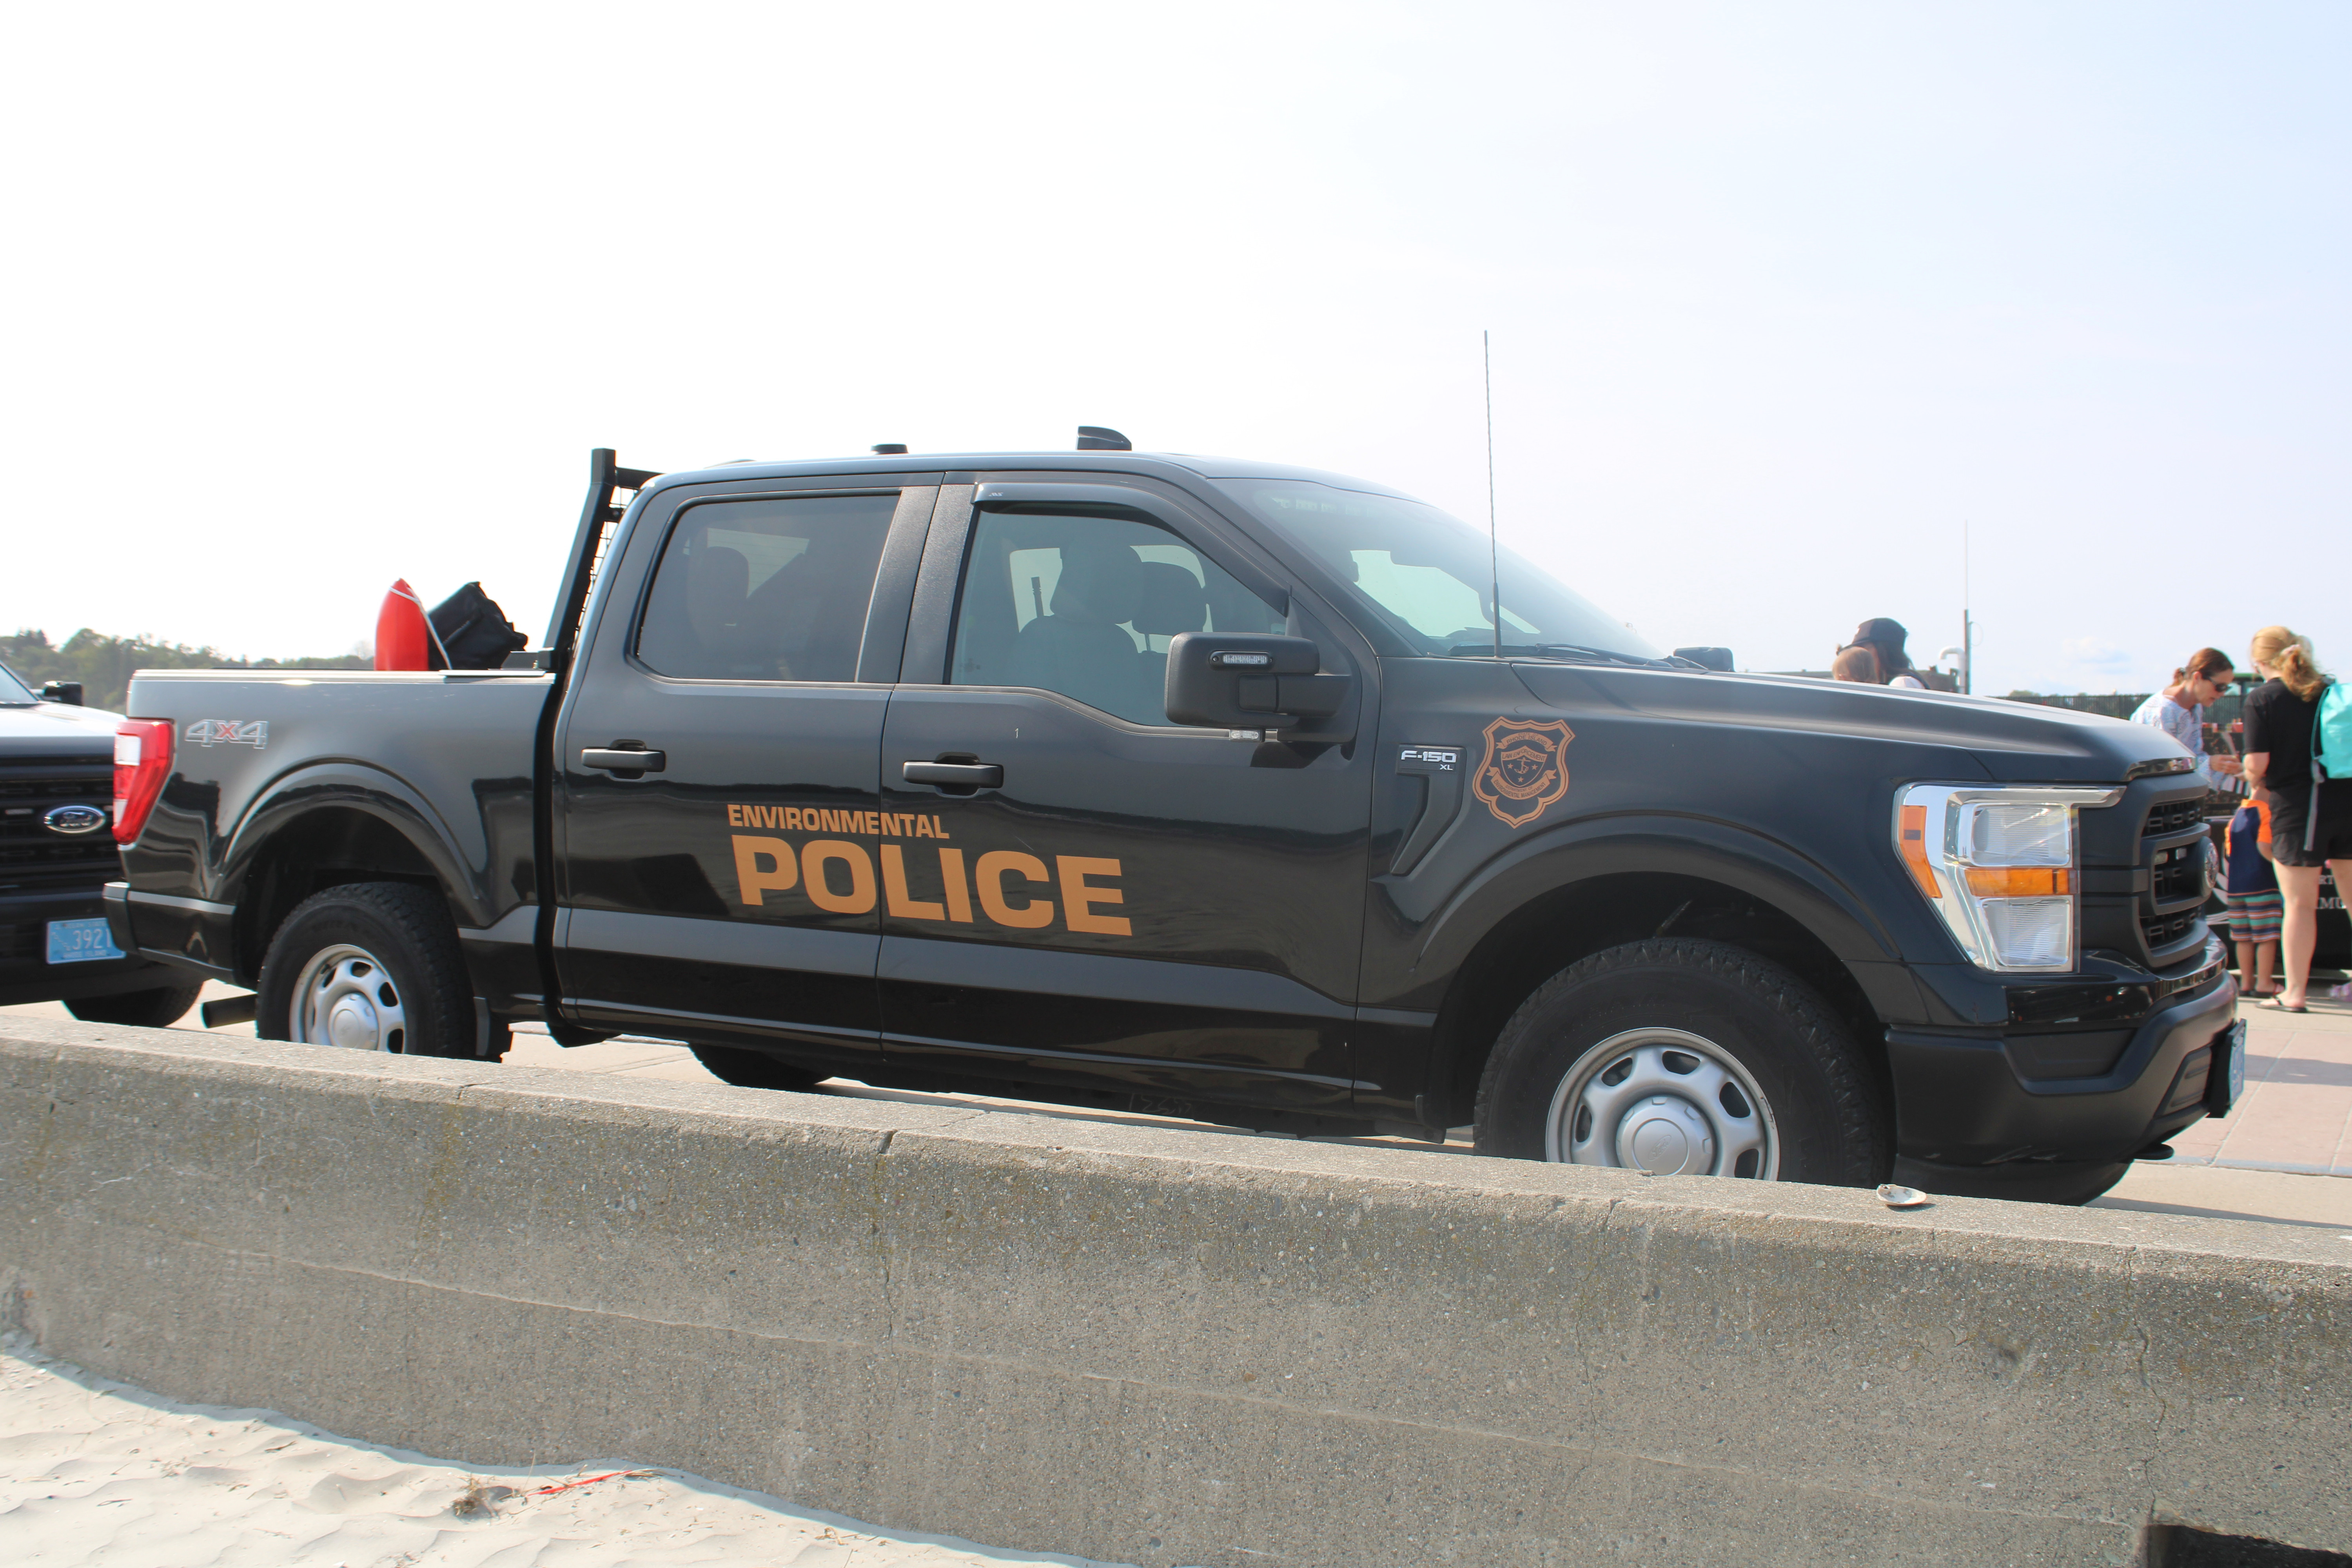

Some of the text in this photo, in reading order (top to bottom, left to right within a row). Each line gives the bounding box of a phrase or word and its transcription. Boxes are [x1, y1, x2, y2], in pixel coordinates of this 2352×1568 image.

[1506, 735, 1547, 745] RHODE ISLAND
[1401, 750, 1457, 763] F-150
[1513, 748, 1546, 761] ENFORCEMENT
[1494, 779, 1546, 798] ENVIRONMENTAL MANAGEMENT
[727, 804, 950, 839] ENVIRONMENTAL
[731, 835, 1132, 936] POLICE
